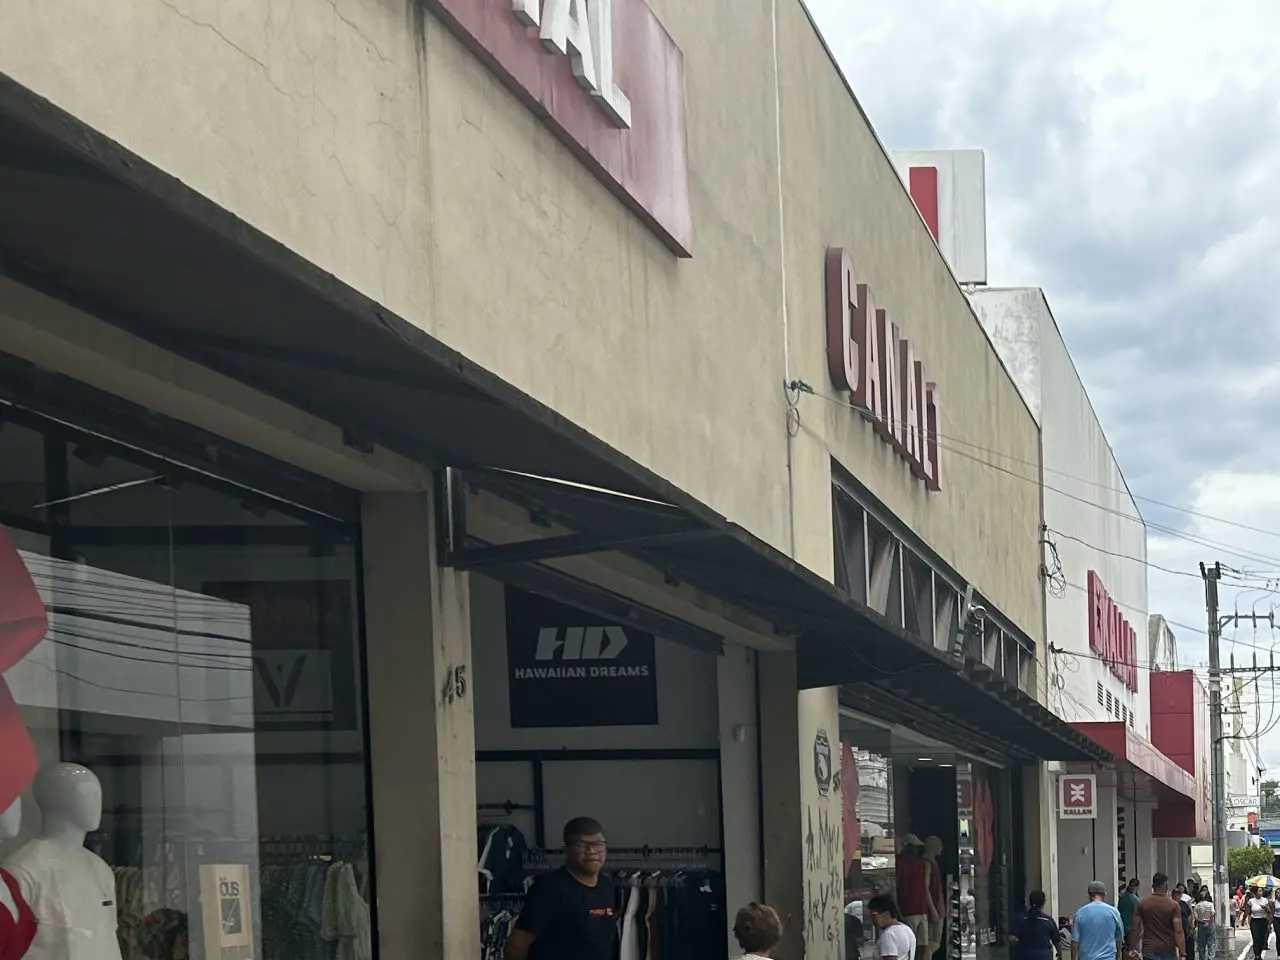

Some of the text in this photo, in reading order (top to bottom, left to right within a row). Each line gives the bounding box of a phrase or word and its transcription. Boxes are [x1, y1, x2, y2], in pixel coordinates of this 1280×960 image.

[535, 625, 628, 660] HD
[515, 665, 649, 679] HAWAIIAN DREAMS
